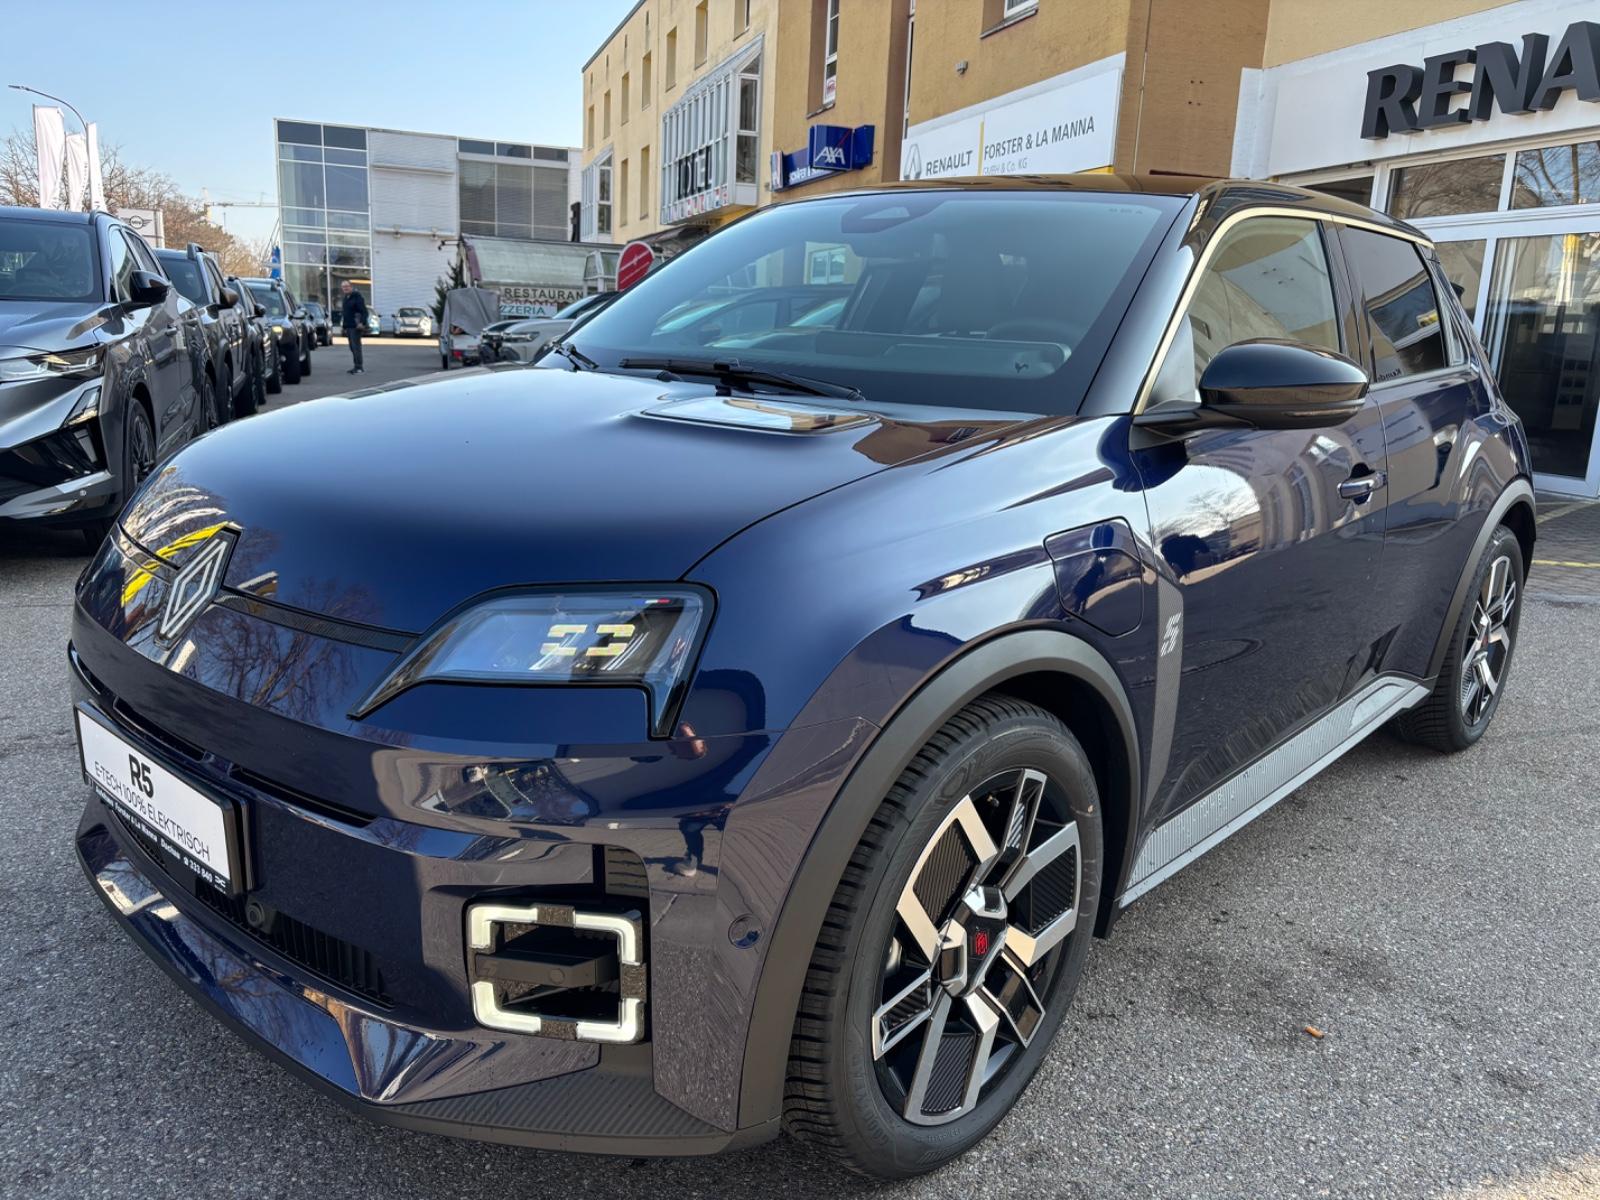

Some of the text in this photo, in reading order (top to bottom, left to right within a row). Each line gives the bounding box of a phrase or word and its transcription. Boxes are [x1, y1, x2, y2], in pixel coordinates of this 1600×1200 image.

[814, 146, 846, 165] AXA
[983, 115, 1096, 161] FORSTER & LA MANNA
[926, 149, 973, 177] RENAULT
[1017, 157, 1028, 169] KG
[128, 753, 155, 800] R5
[121, 781, 147, 816] 100%
[147, 800, 211, 862] ELEKTRISCH
